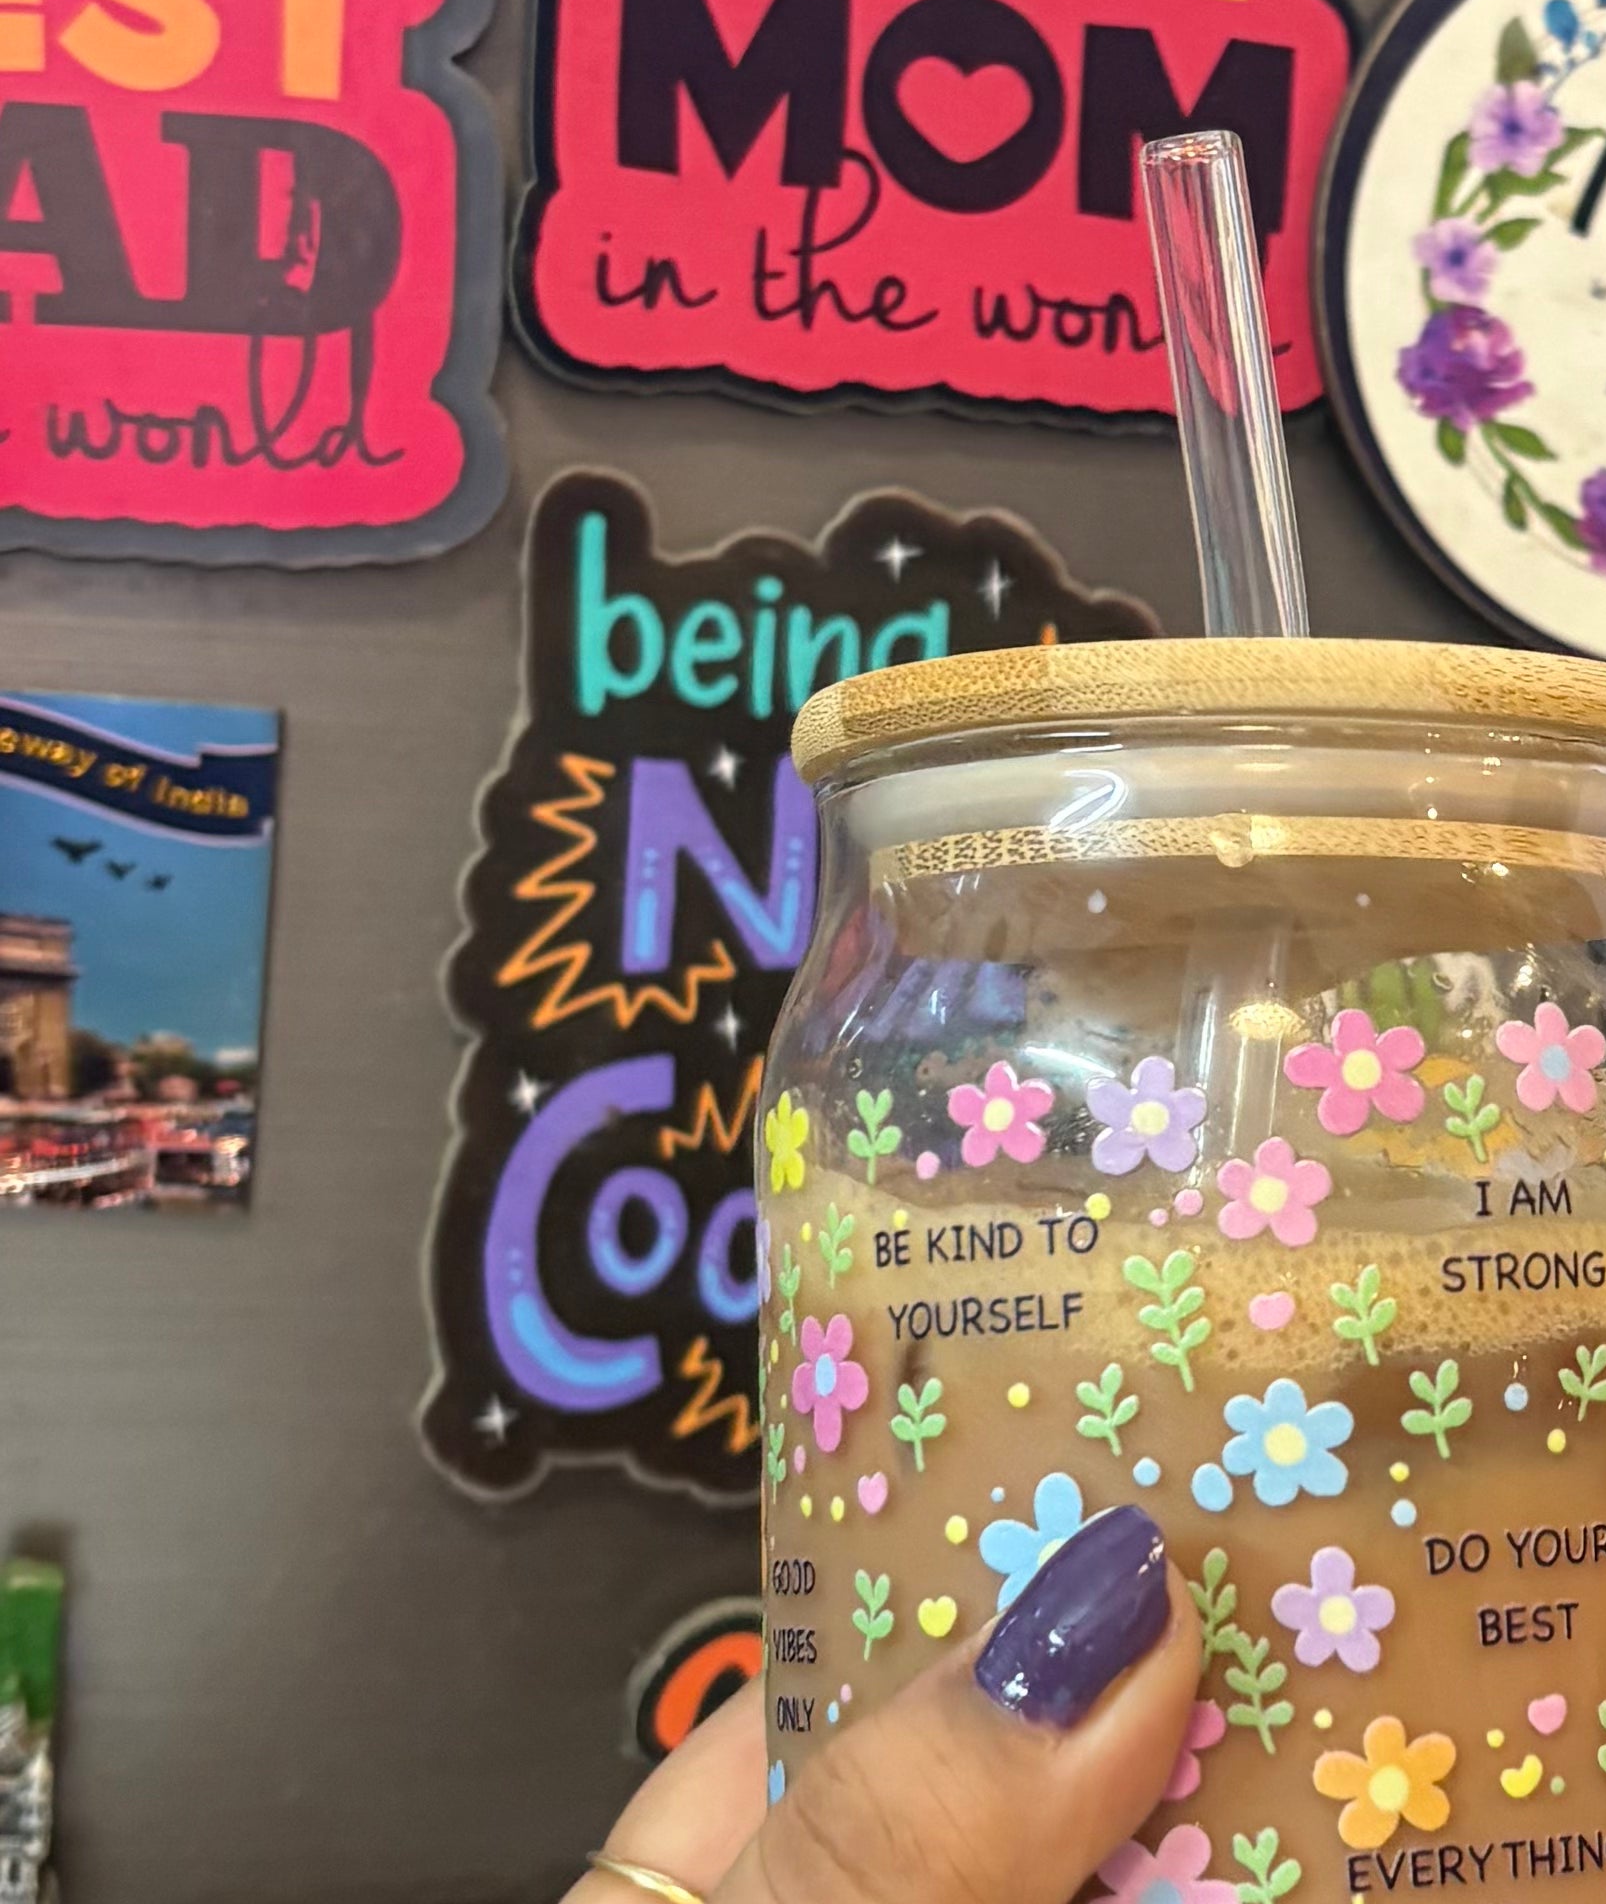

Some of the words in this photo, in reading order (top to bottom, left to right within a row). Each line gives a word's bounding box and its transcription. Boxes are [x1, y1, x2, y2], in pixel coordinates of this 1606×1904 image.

[0, 104, 402, 338] AD
[595, 230, 716, 313] in
[753, 151, 940, 331] the
[0, 727, 97, 779] eway
[154, 774, 250, 820] India
[1475, 1181, 1491, 1217] I
[1509, 1179, 1572, 1216] AM
[873, 1227, 910, 1269] BE
[926, 1221, 1025, 1263] KIND
[1038, 1215, 1099, 1256] TO
[1441, 1250, 1606, 1294] STRONG
[888, 1291, 1086, 1342] YOURSELF
[1425, 1533, 1491, 1576] DO
[772, 1559, 816, 1596] GOOD
[773, 1628, 818, 1664] VIBES
[1477, 1603, 1580, 1648] BEST
[776, 1696, 815, 1733] ONLY
